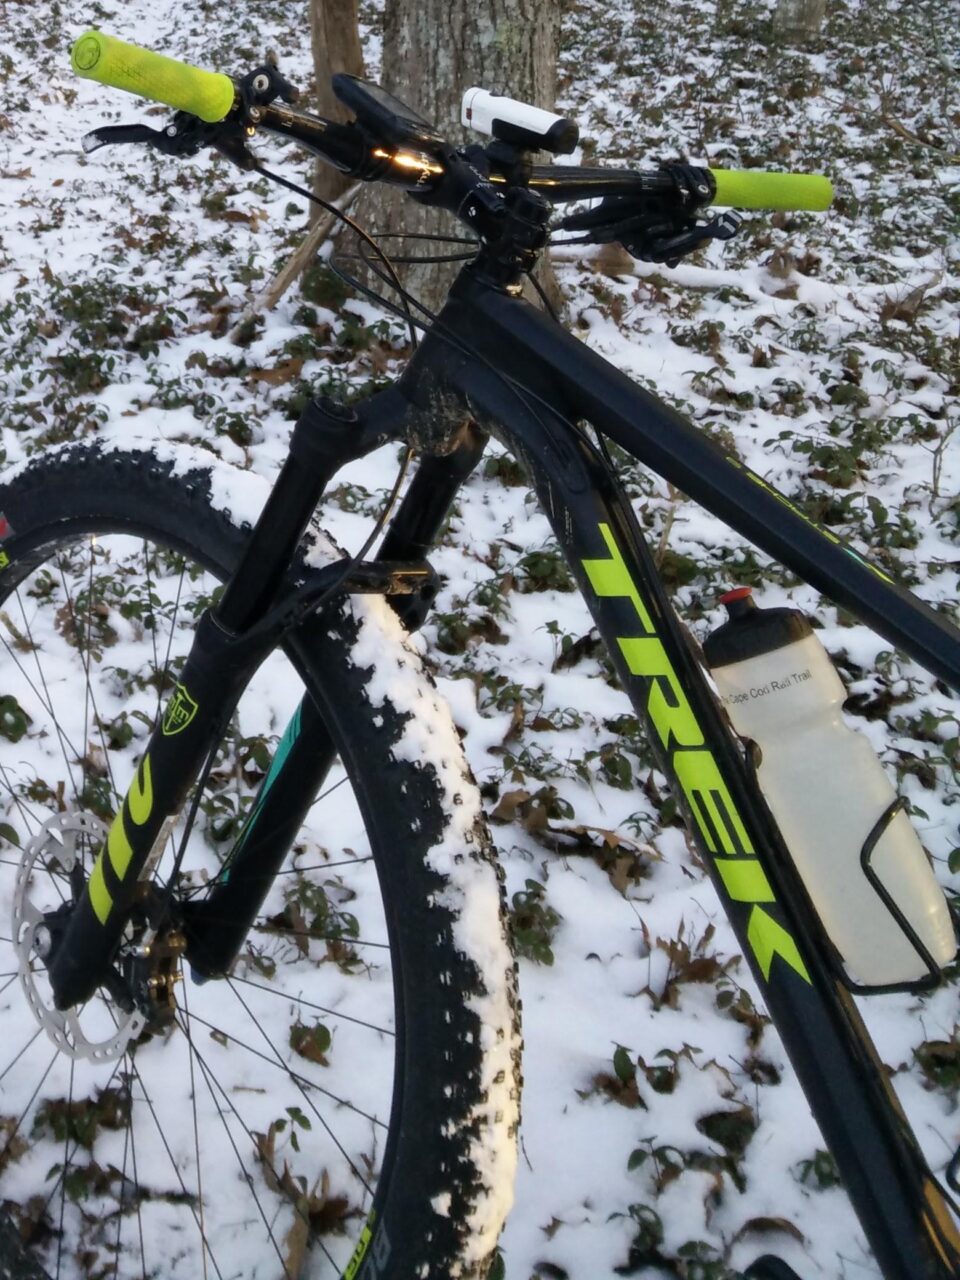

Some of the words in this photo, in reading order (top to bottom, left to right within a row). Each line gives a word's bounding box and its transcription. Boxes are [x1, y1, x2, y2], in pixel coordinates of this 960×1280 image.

[581, 523, 812, 985] TREK
[729, 693, 749, 704] Cape
[791, 669, 813, 684] Trail
